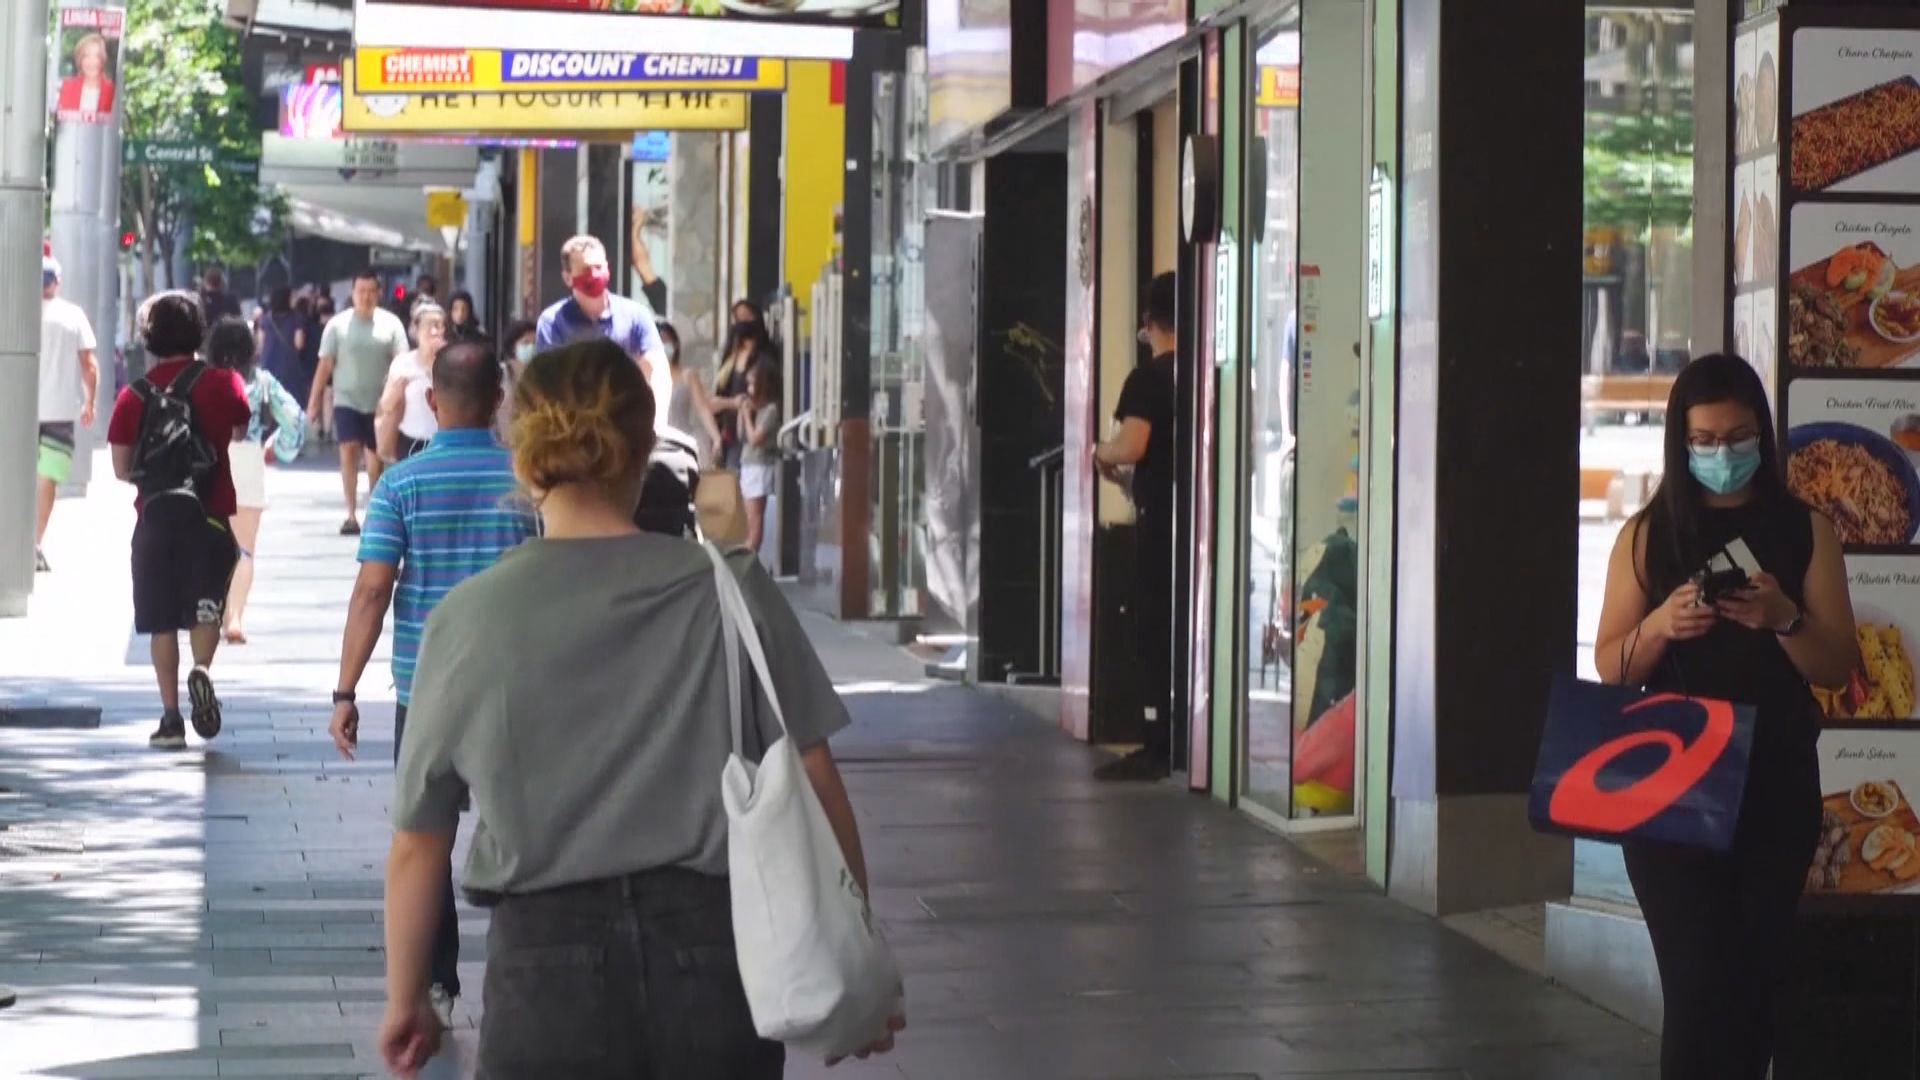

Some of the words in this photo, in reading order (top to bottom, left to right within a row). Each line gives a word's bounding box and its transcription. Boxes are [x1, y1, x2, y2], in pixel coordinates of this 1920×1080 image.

[386, 55, 470, 73] CHEMIST
[510, 52, 637, 77] DISCOUNT
[643, 55, 745, 76] CHEMIST
[145, 144, 197, 160] Central
[1834, 220, 1871, 233] Chicken
[1825, 396, 1863, 409] Chicken
[1865, 396, 1892, 409] Fried
